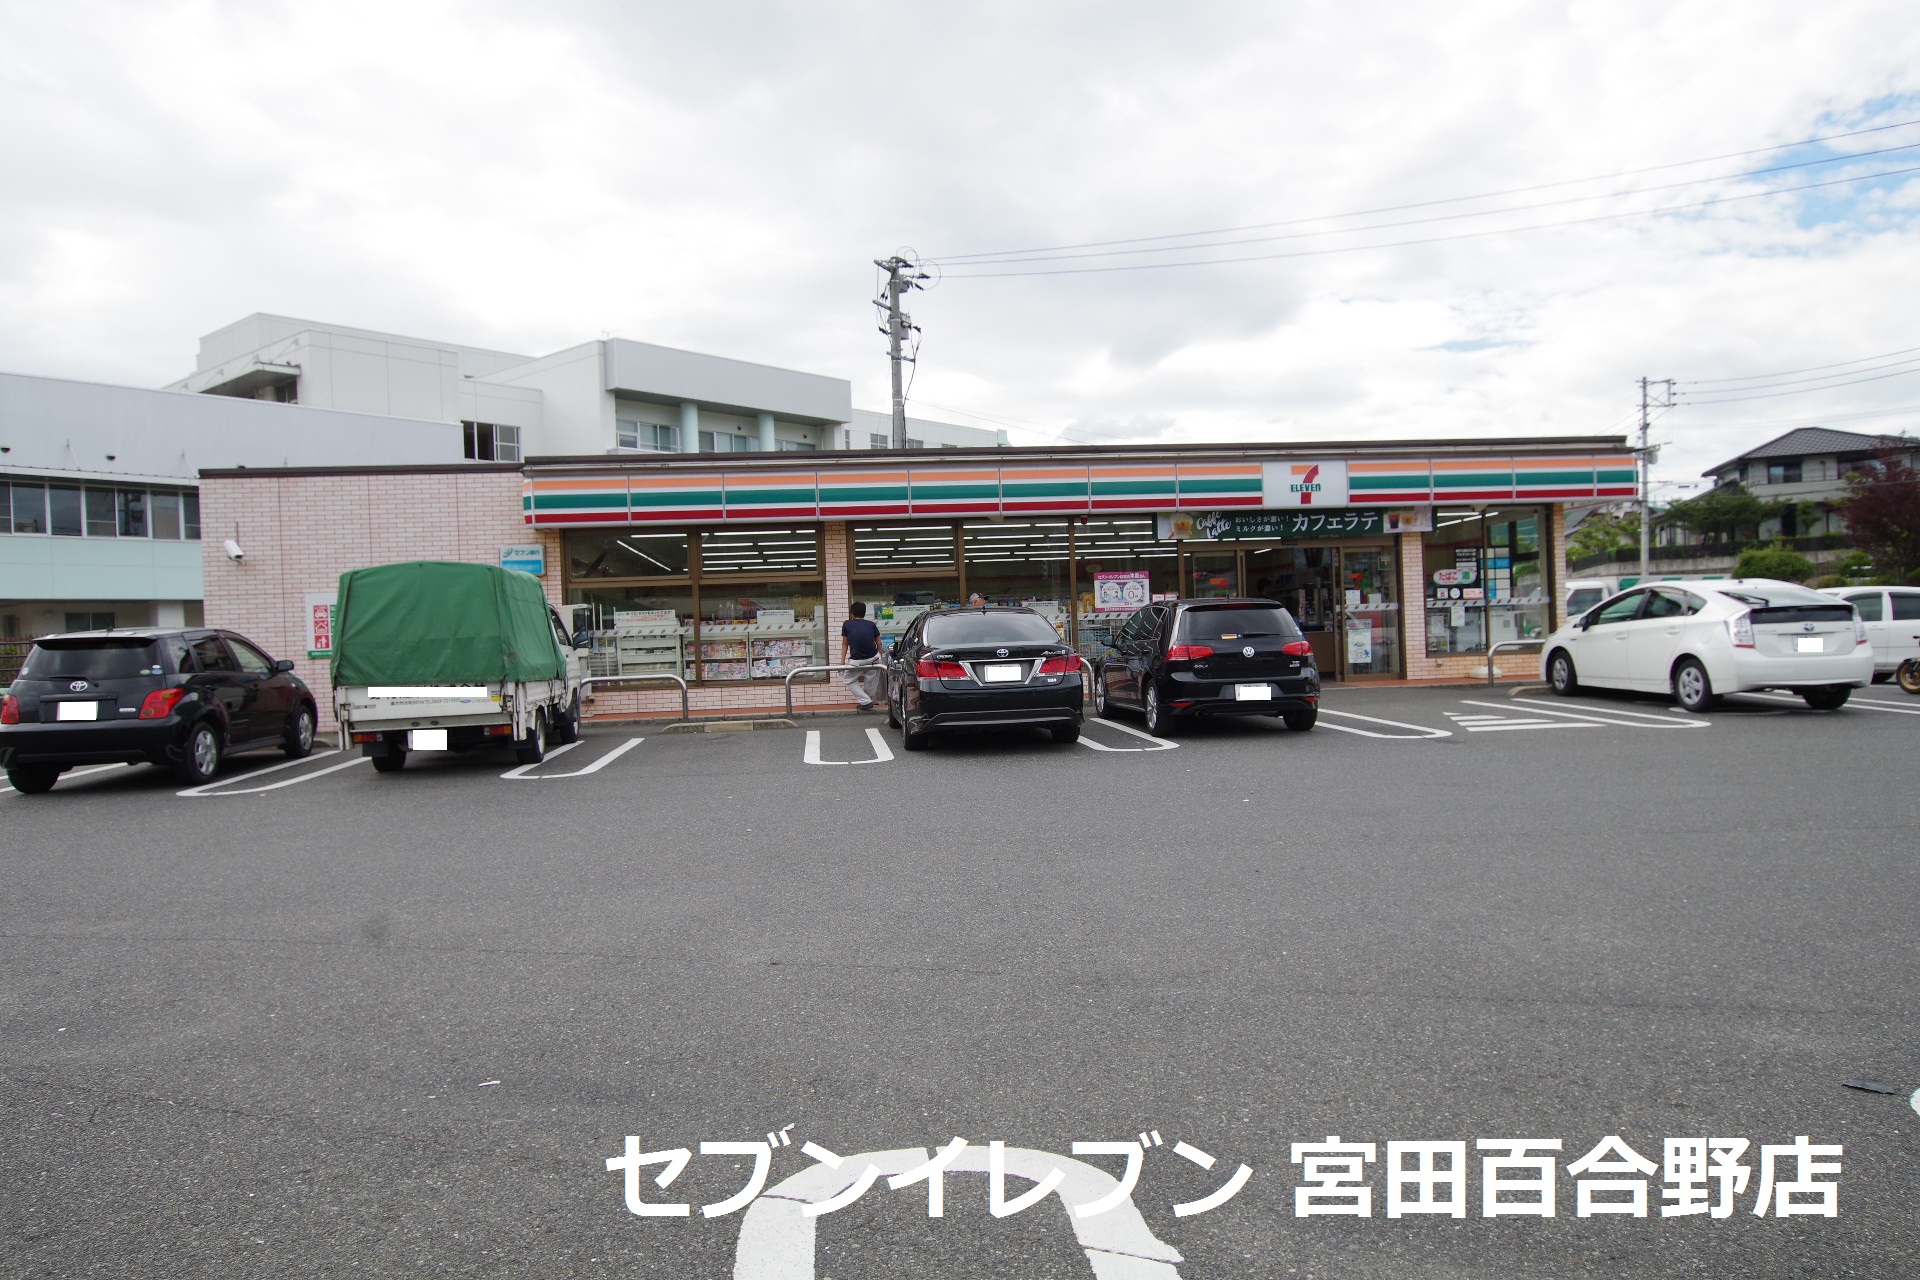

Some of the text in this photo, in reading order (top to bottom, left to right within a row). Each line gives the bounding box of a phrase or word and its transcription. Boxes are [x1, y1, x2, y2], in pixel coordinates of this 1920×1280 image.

[1291, 511, 1379, 532] カフェラテ
[1438, 571, 1458, 581] たばこ
